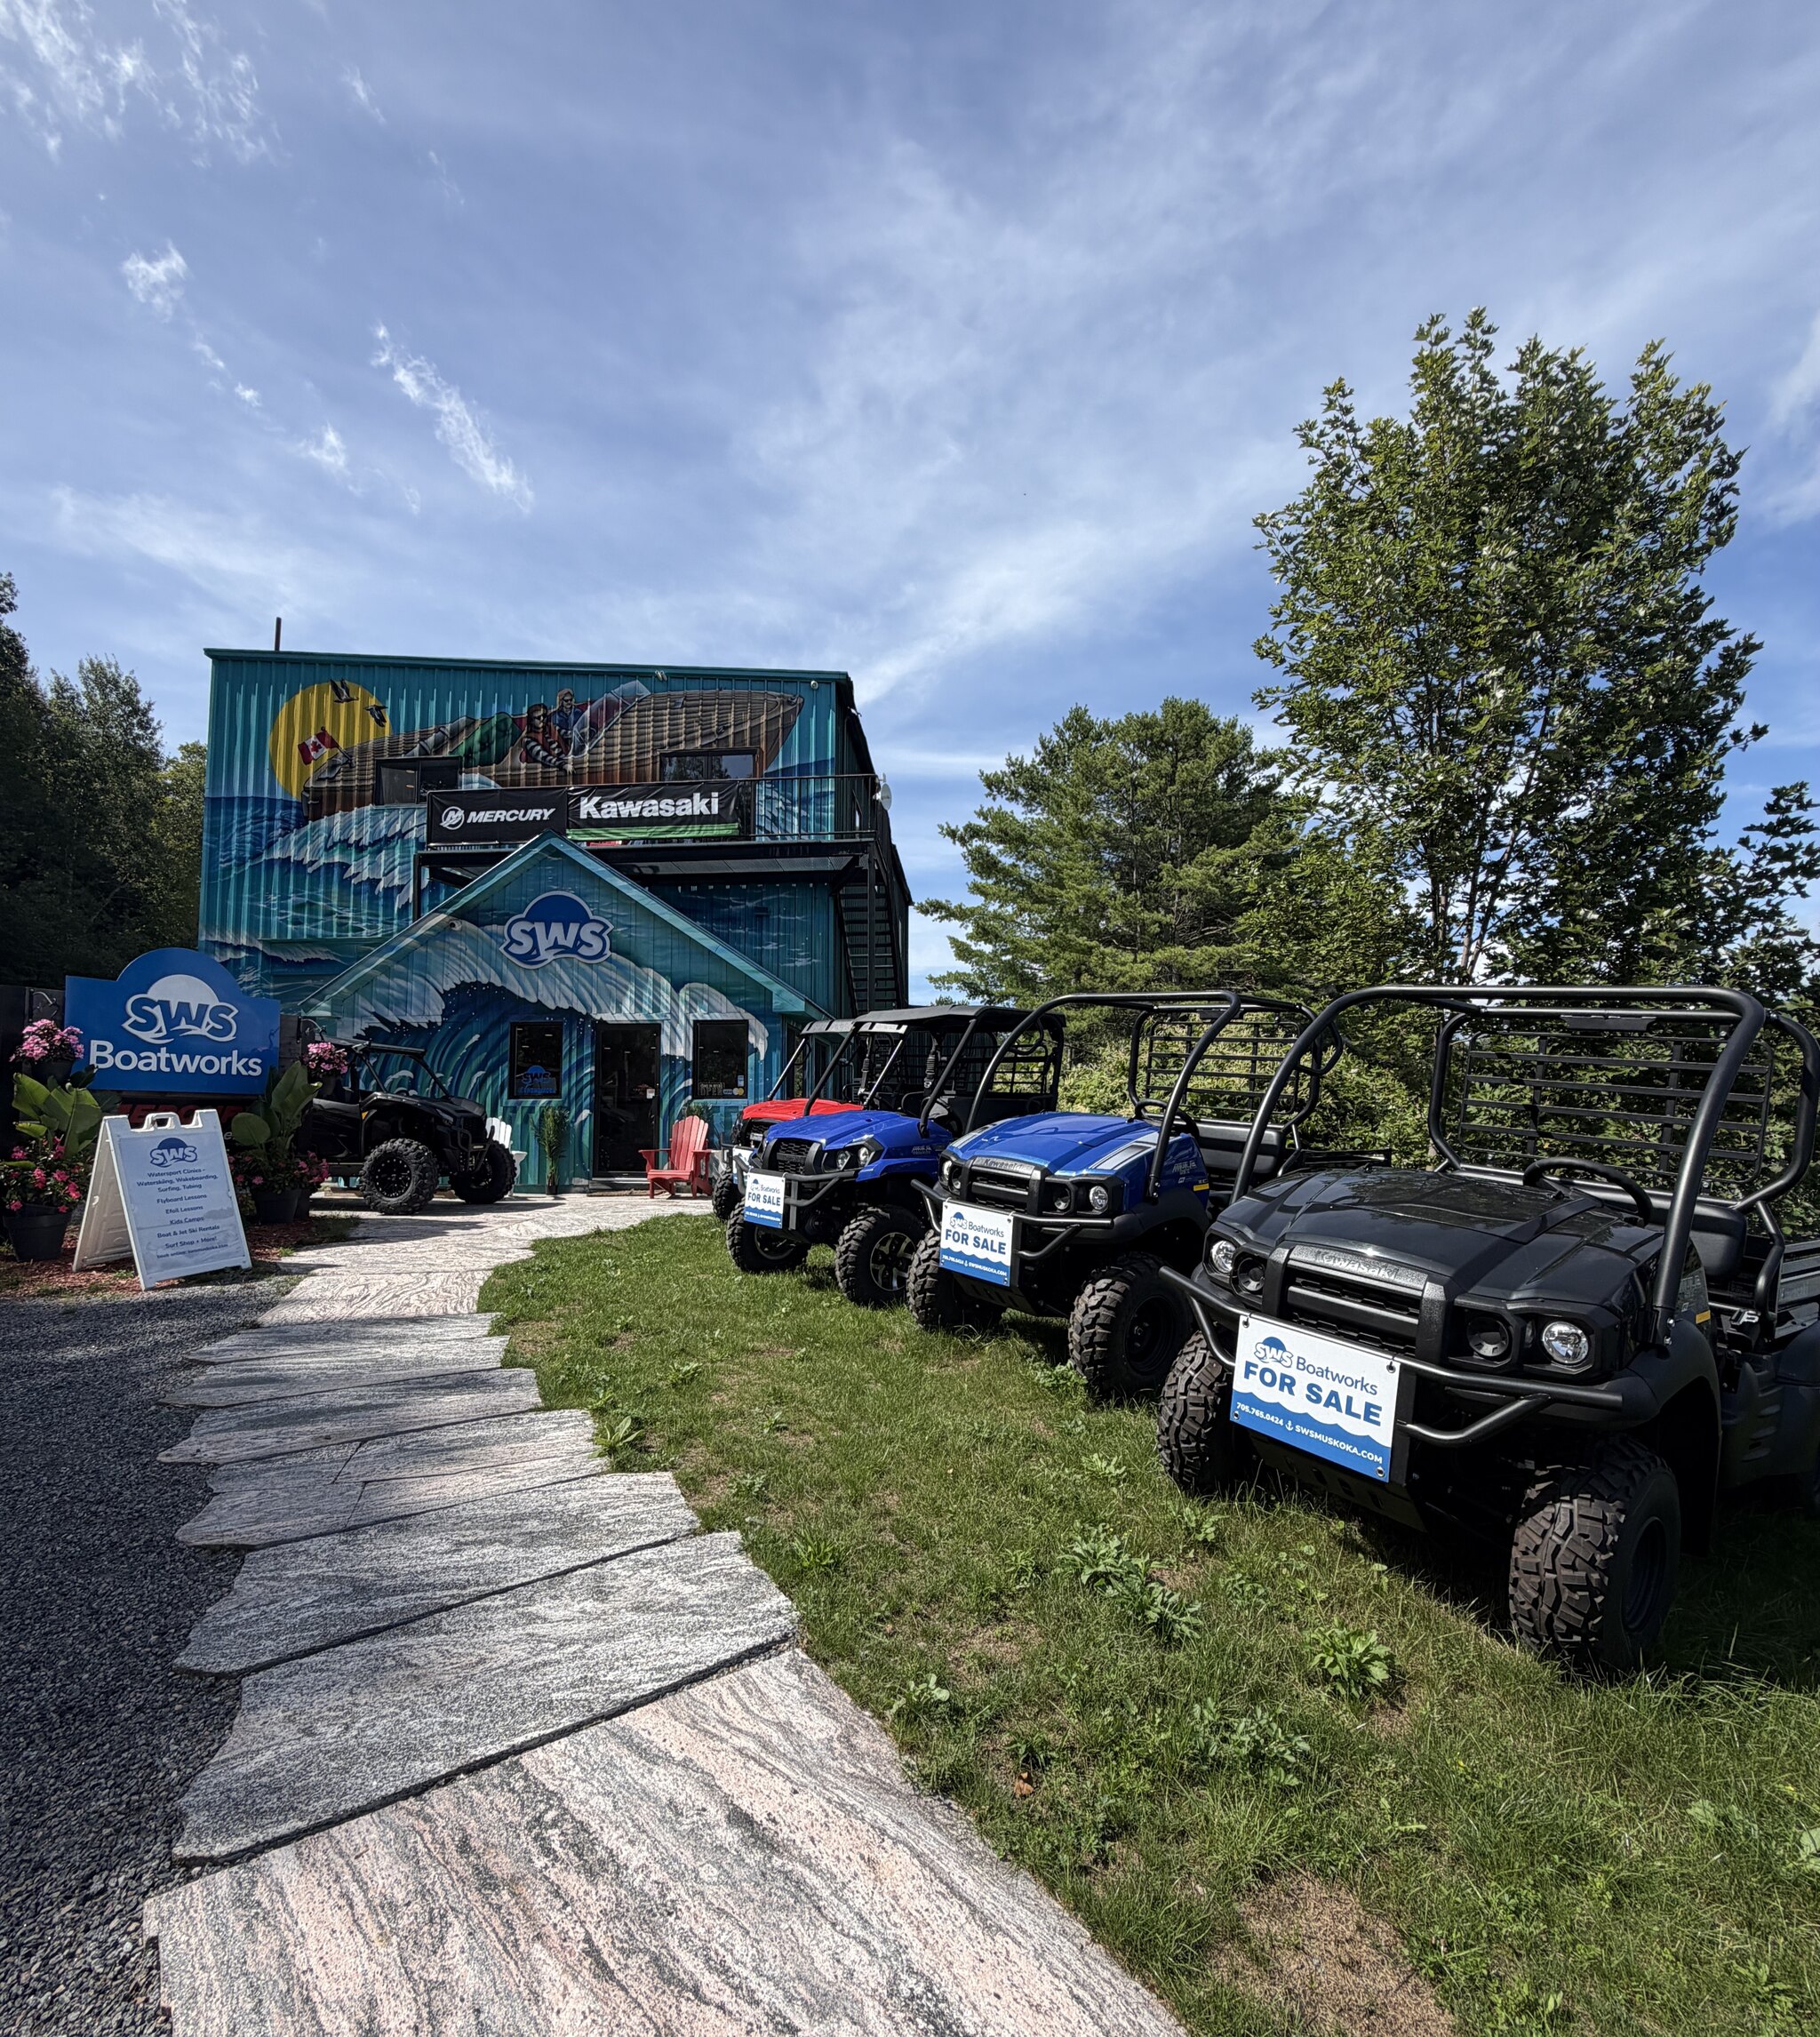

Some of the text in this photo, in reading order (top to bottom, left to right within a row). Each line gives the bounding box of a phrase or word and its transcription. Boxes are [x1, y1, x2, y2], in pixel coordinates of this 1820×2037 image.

[467, 808, 556, 824] MERCURY
[579, 792, 719, 819] Kawasaki
[504, 919, 608, 961] SWS
[122, 994, 238, 1042] SWS
[89, 1039, 262, 1076] Boatworks
[149, 1146, 198, 1168] SWS
[156, 1195, 183, 1204] Flyboard
[747, 1192, 781, 1206] FOR SALE
[945, 1229, 1007, 1255] FOR SALE
[968, 1221, 1004, 1238] Boatworks
[1315, 1250, 1400, 1280] Kawasaki
[1254, 1341, 1378, 1396] SWS Boatworks
[1243, 1360, 1383, 1426] FOR SALE
[1236, 1402, 1383, 1465] 705.765.0424 SWSMUSKOKA.COM
